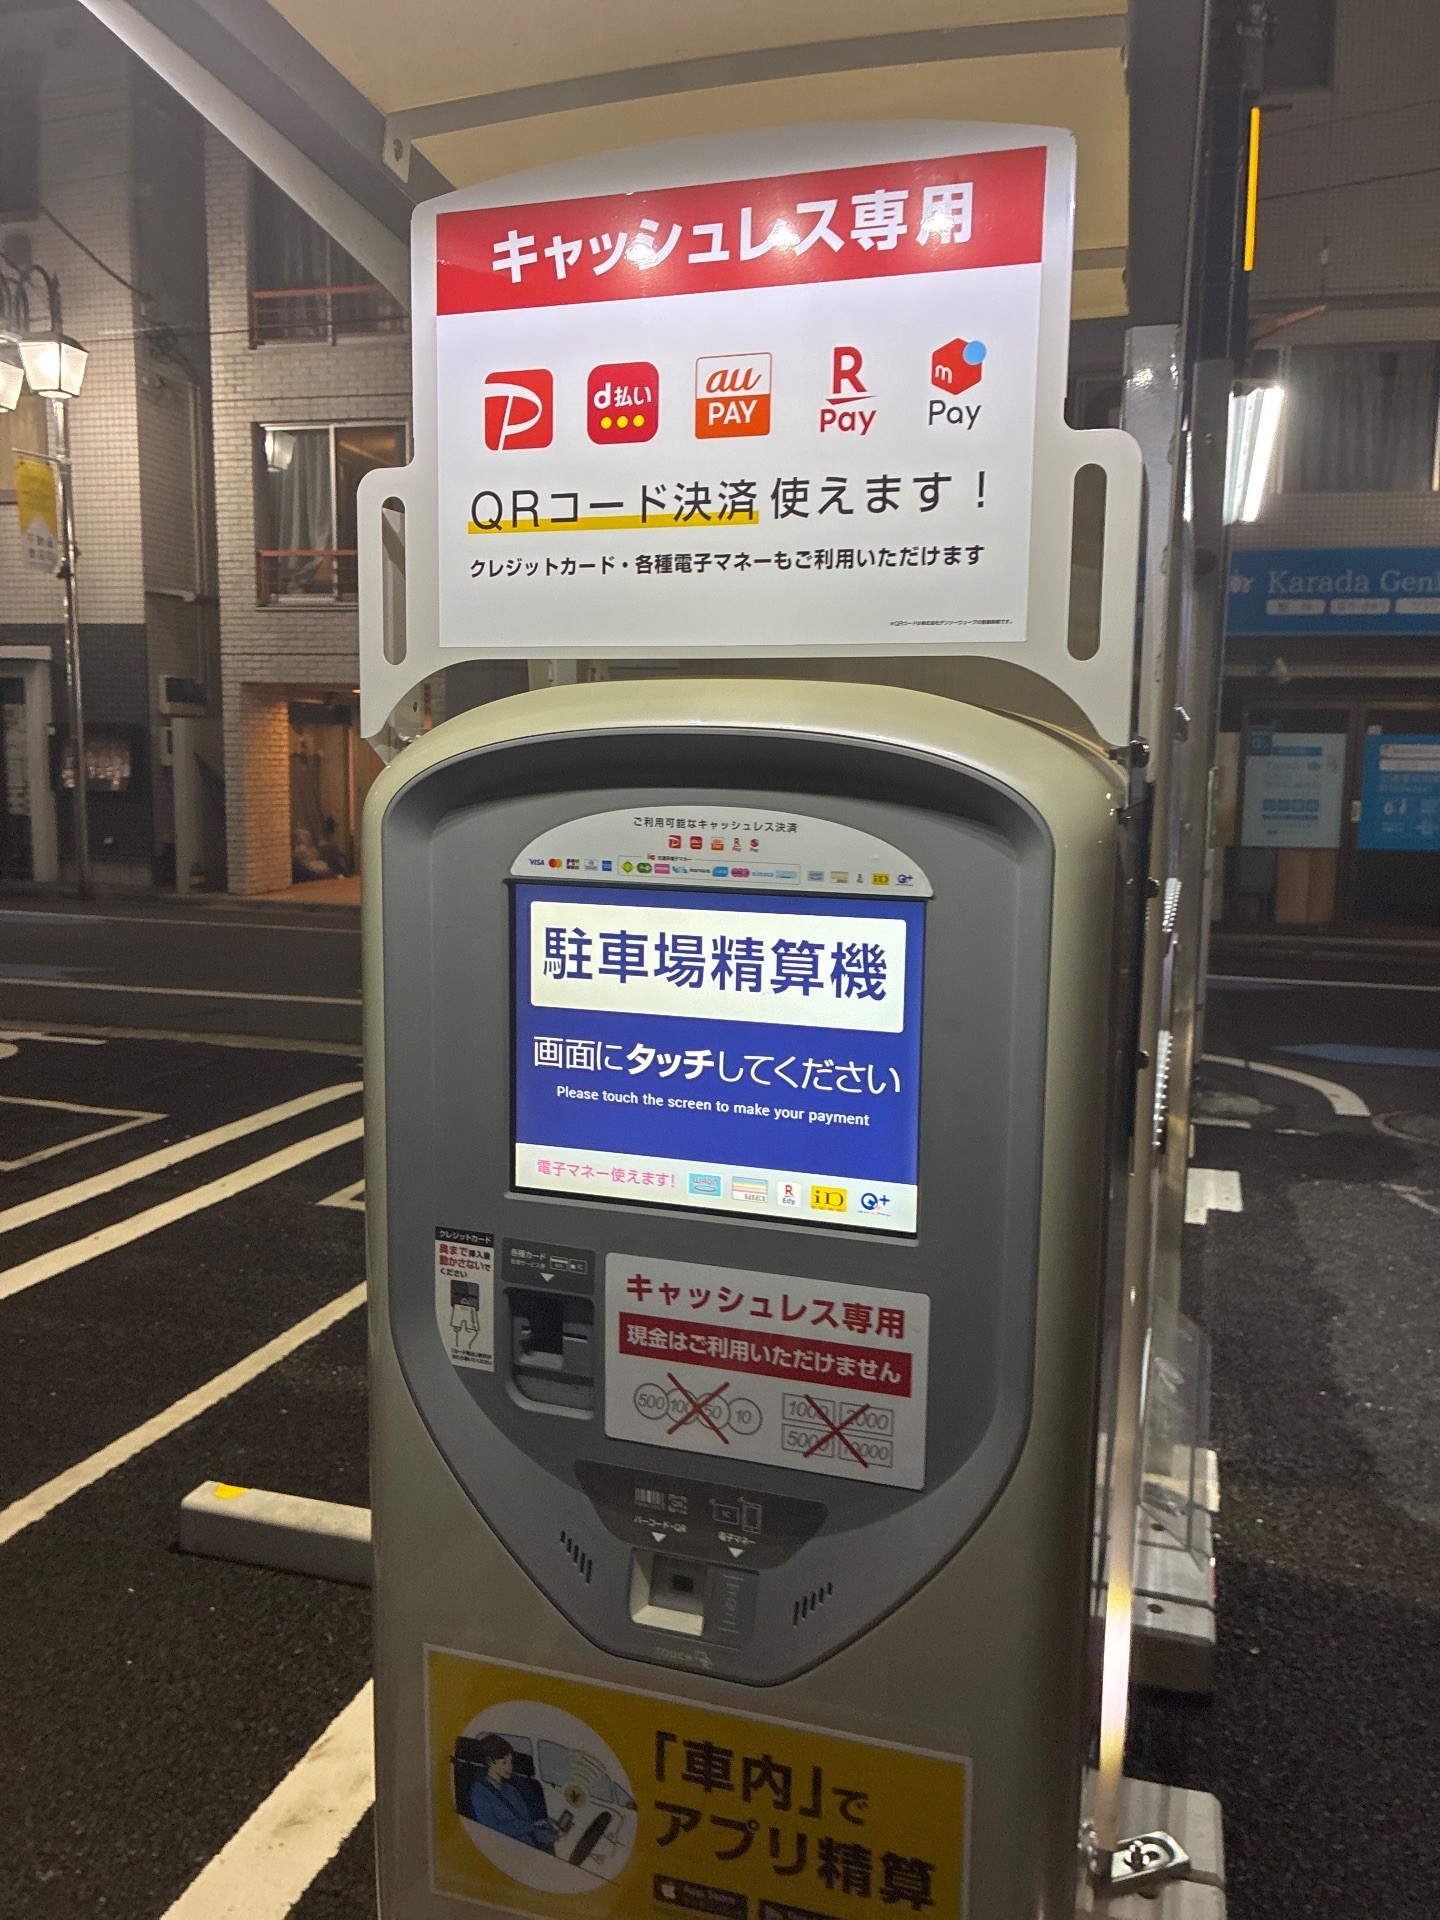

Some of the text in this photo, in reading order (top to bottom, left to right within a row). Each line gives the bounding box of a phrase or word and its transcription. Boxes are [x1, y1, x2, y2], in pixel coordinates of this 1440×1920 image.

[492, 180, 975, 285] キャッシュレス専用
[704, 366, 763, 393] au
[593, 382, 652, 411] d払い
[707, 400, 758, 427] PAY
[819, 407, 877, 436] Pay
[928, 399, 983, 430] Pay
[469, 544, 987, 579] クレジットカード・各種電子マネーもご利用いただけます
[1268, 570, 1369, 594] Karada
[633, 816, 798, 834] ご利用可能なキャッシュレス決済
[529, 858, 545, 866] VISA
[543, 926, 887, 1001] 駐車場精算機
[533, 1036, 900, 1095] 画面にタッチしてください
[556, 1085, 870, 1127] Please touch the screen to make your payment
[782, 1197, 795, 1206] Edy
[814, 1189, 844, 1207] iD
[440, 1268, 468, 1278] ください
[626, 1274, 906, 1340] キャッシュレス専用
[626, 1324, 901, 1384] 現金はご利用いただけません
[639, 1394, 664, 1411] 500
[671, 1399, 697, 1416] 10
[736, 1410, 752, 1425] 10
[843, 1440, 889, 1461] 000
[654, 1730, 869, 1827] 「車内」で
[654, 1800, 936, 1912] アプリ精算
